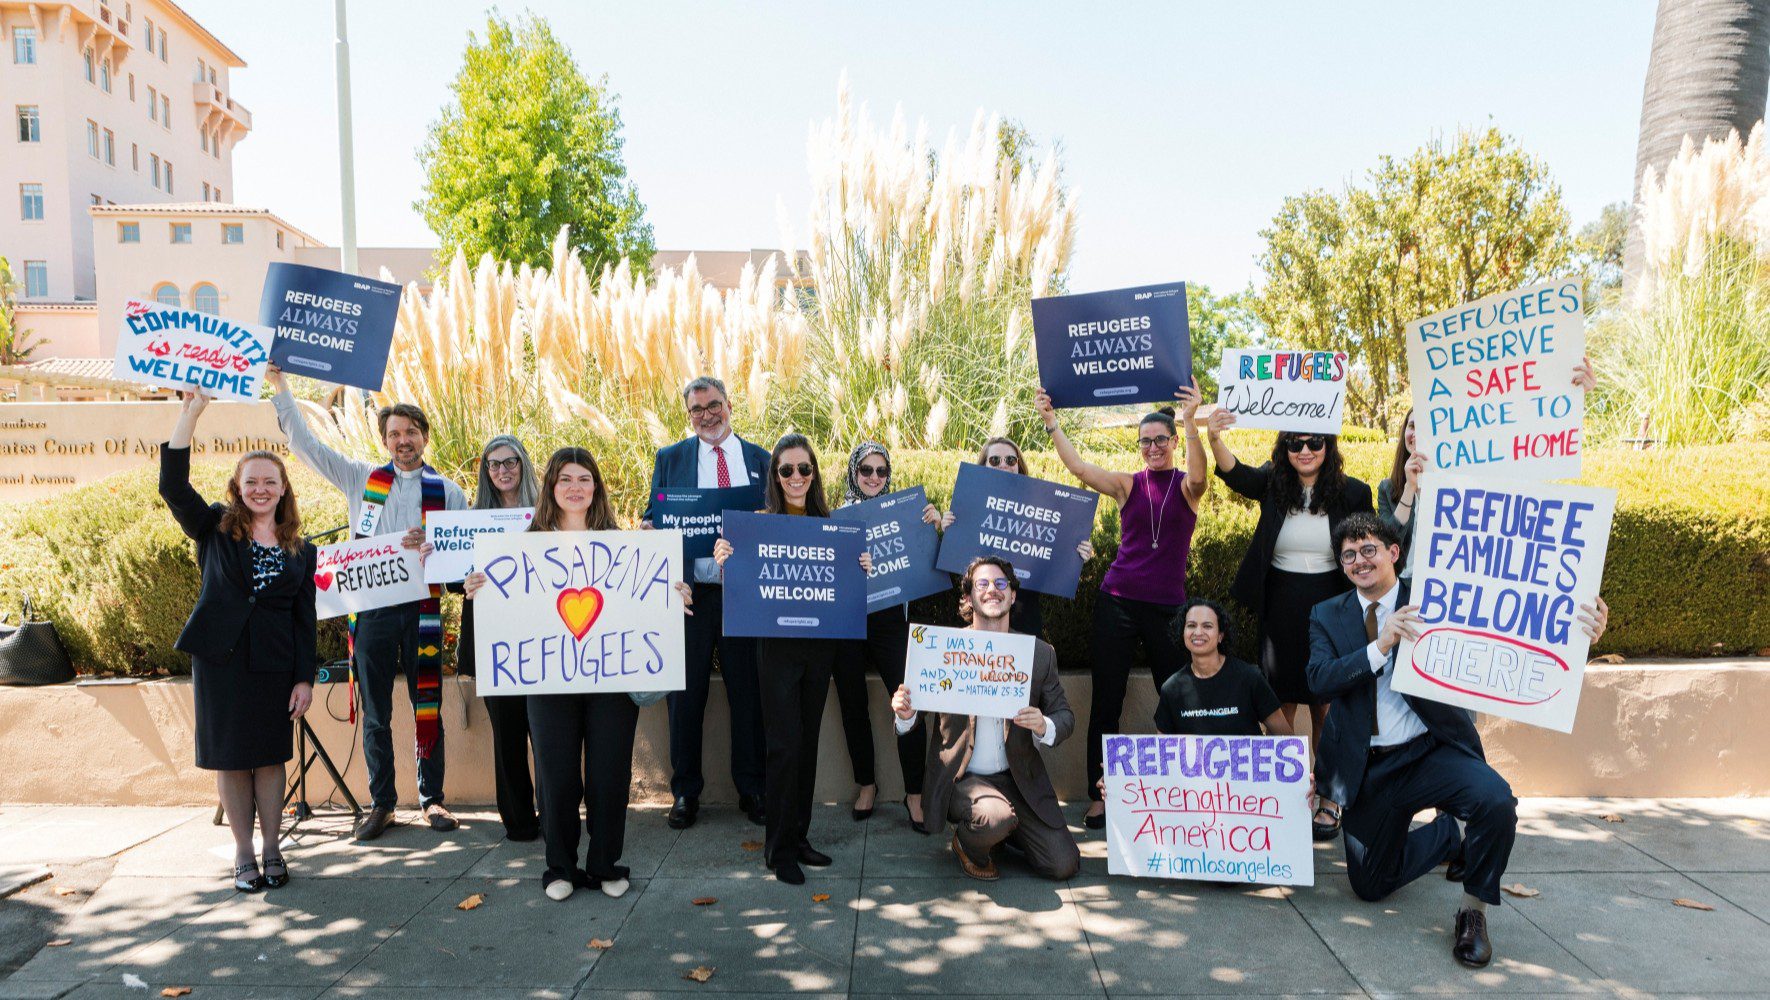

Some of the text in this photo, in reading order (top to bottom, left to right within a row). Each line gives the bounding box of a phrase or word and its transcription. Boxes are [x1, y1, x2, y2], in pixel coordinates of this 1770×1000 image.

[353, 282, 371, 290] IRAP
[1134, 292, 1152, 300] IRAP
[285, 290, 362, 316] REFUGEES
[1419, 284, 1579, 342] REFUGEES
[280, 307, 358, 335] ALWAYS
[1068, 316, 1151, 338] REFUGEES
[126, 310, 268, 366] COMMUNITY
[277, 325, 354, 353] WELCOME
[1070, 333, 1153, 358] ALWAYS
[1426, 325, 1554, 370] DESERVE
[143, 335, 251, 372] is ready to
[1072, 355, 1155, 375] WELCOME
[1239, 352, 1348, 382] REFUGEES
[128, 355, 255, 397] WELCOME
[1429, 361, 1541, 402] A SAFE
[1223, 385, 1340, 419] Welcome!
[1429, 394, 1572, 437] PLACE TO
[0, 436, 289, 459] ates Court Of Apls Building
[1436, 428, 1579, 469] CALL HOME
[880, 500, 896, 509] IRAP
[1054, 489, 1070, 498] IRAP
[662, 514, 722, 526] My people
[985, 496, 1062, 524] REFUGEES
[1434, 488, 1594, 547] REFUGEE
[662, 525, 715, 537] ugees
[981, 513, 1057, 543] ALWAYS
[317, 545, 399, 570] California
[434, 540, 474, 551] Welc
[758, 544, 835, 561] REFUGEES
[979, 532, 1052, 560] WELCOME
[335, 557, 409, 593] REFUGEES
[484, 541, 669, 609] PASADENA
[758, 562, 835, 583] ALWAYS
[866, 555, 911, 579] COME
[1428, 532, 1581, 593] FAMILIES
[759, 585, 835, 601] WELCOME
[1418, 577, 1575, 645] BELONG
[492, 630, 664, 687] REFUGEES
[946, 637, 974, 650] WAS
[985, 640, 993, 652] A
[943, 651, 1015, 671] STRANGER
[1424, 635, 1557, 700] HERE
[920, 668, 1029, 684] AND YOU WELCOMED
[1106, 736, 1305, 783] REFUGEES
[1133, 813, 1270, 852] America
[1147, 852, 1293, 881] #iamlosangeles
